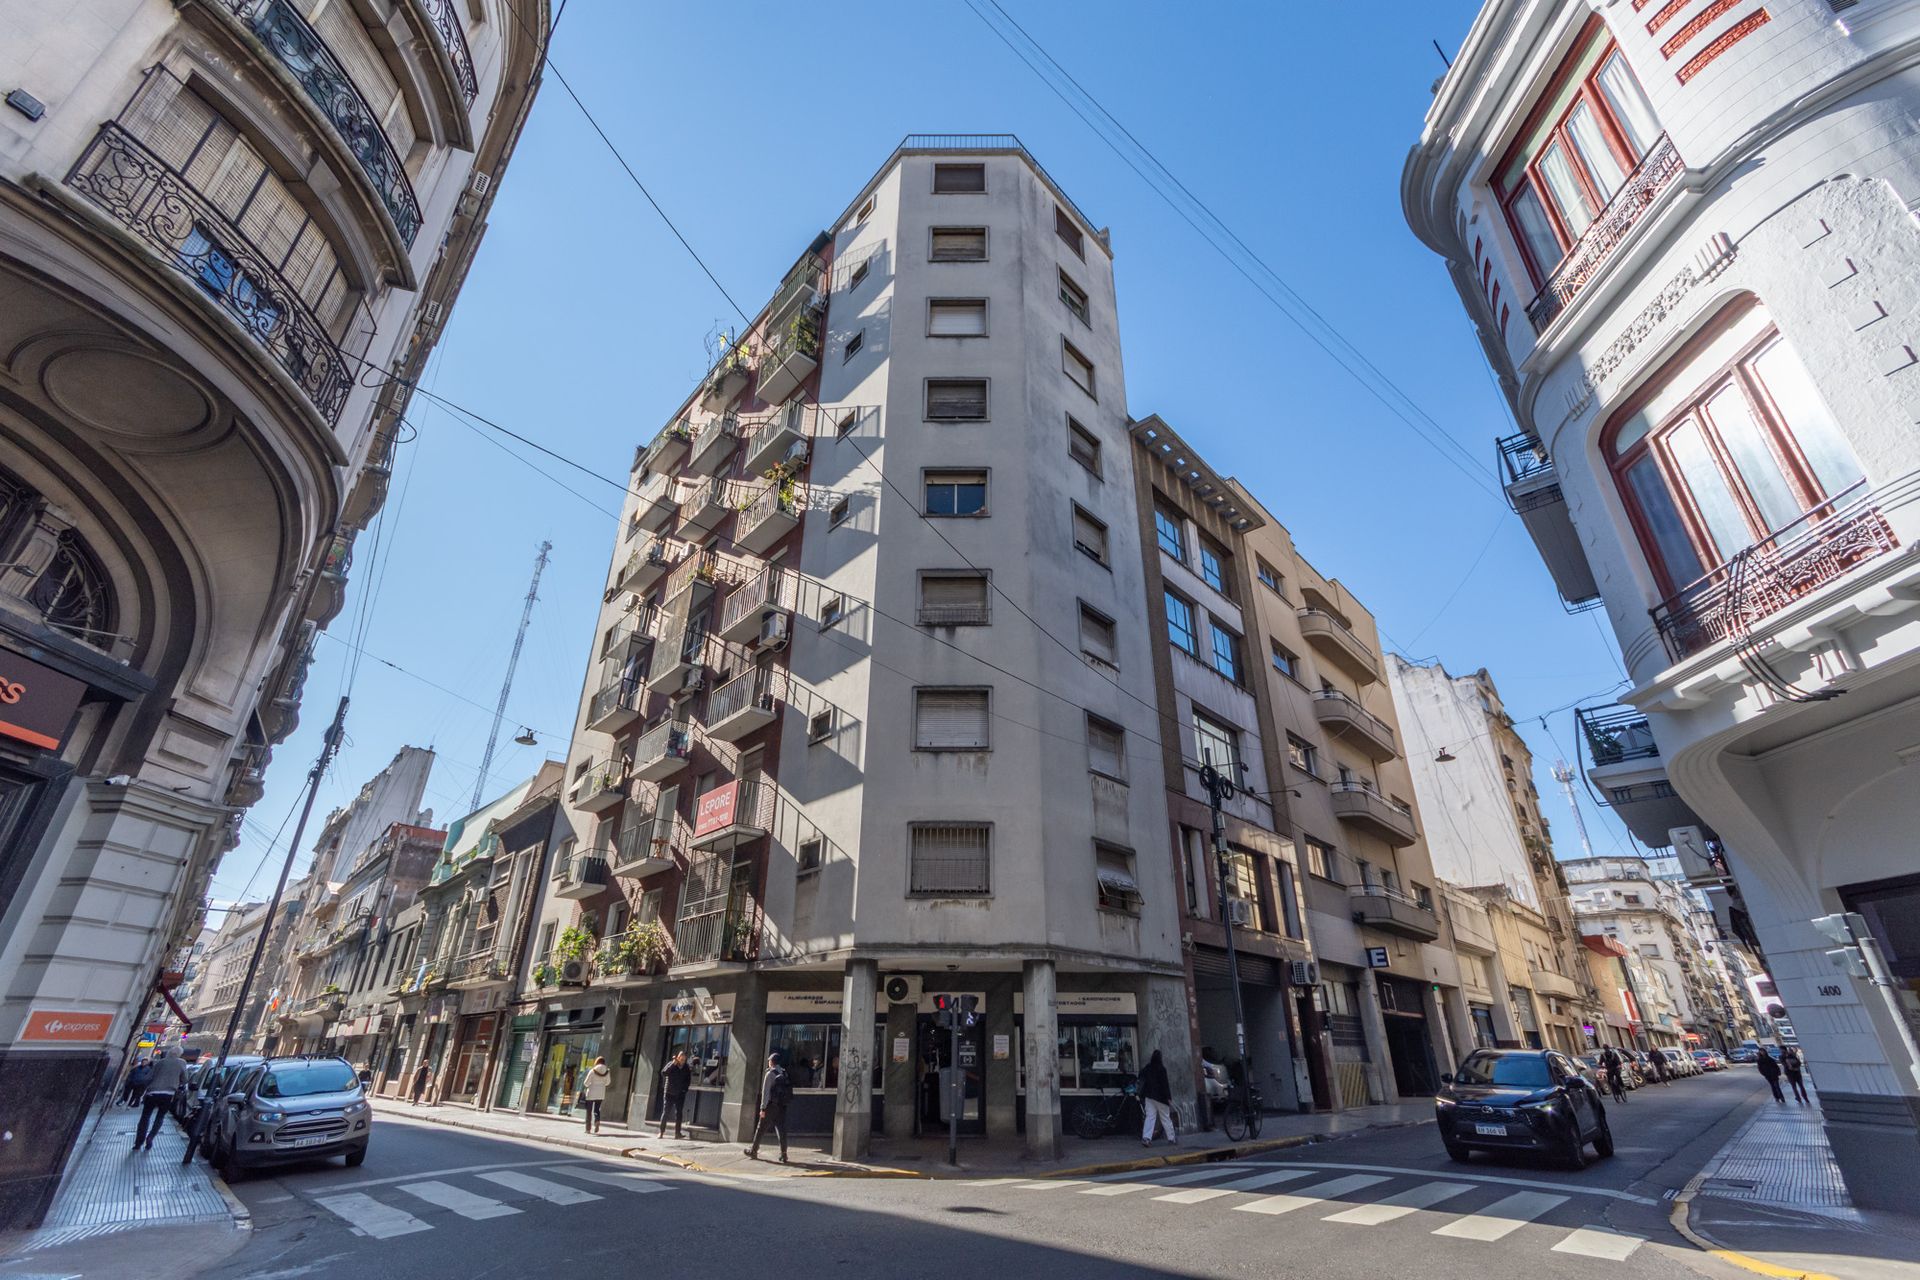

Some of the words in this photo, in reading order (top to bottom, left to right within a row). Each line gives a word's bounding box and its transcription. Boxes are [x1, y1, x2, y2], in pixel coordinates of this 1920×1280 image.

[700, 791, 732, 816] LEPORE
[1370, 948, 1387, 966] E
[1817, 985, 1842, 996] 1400
[63, 1022, 101, 1032] express
